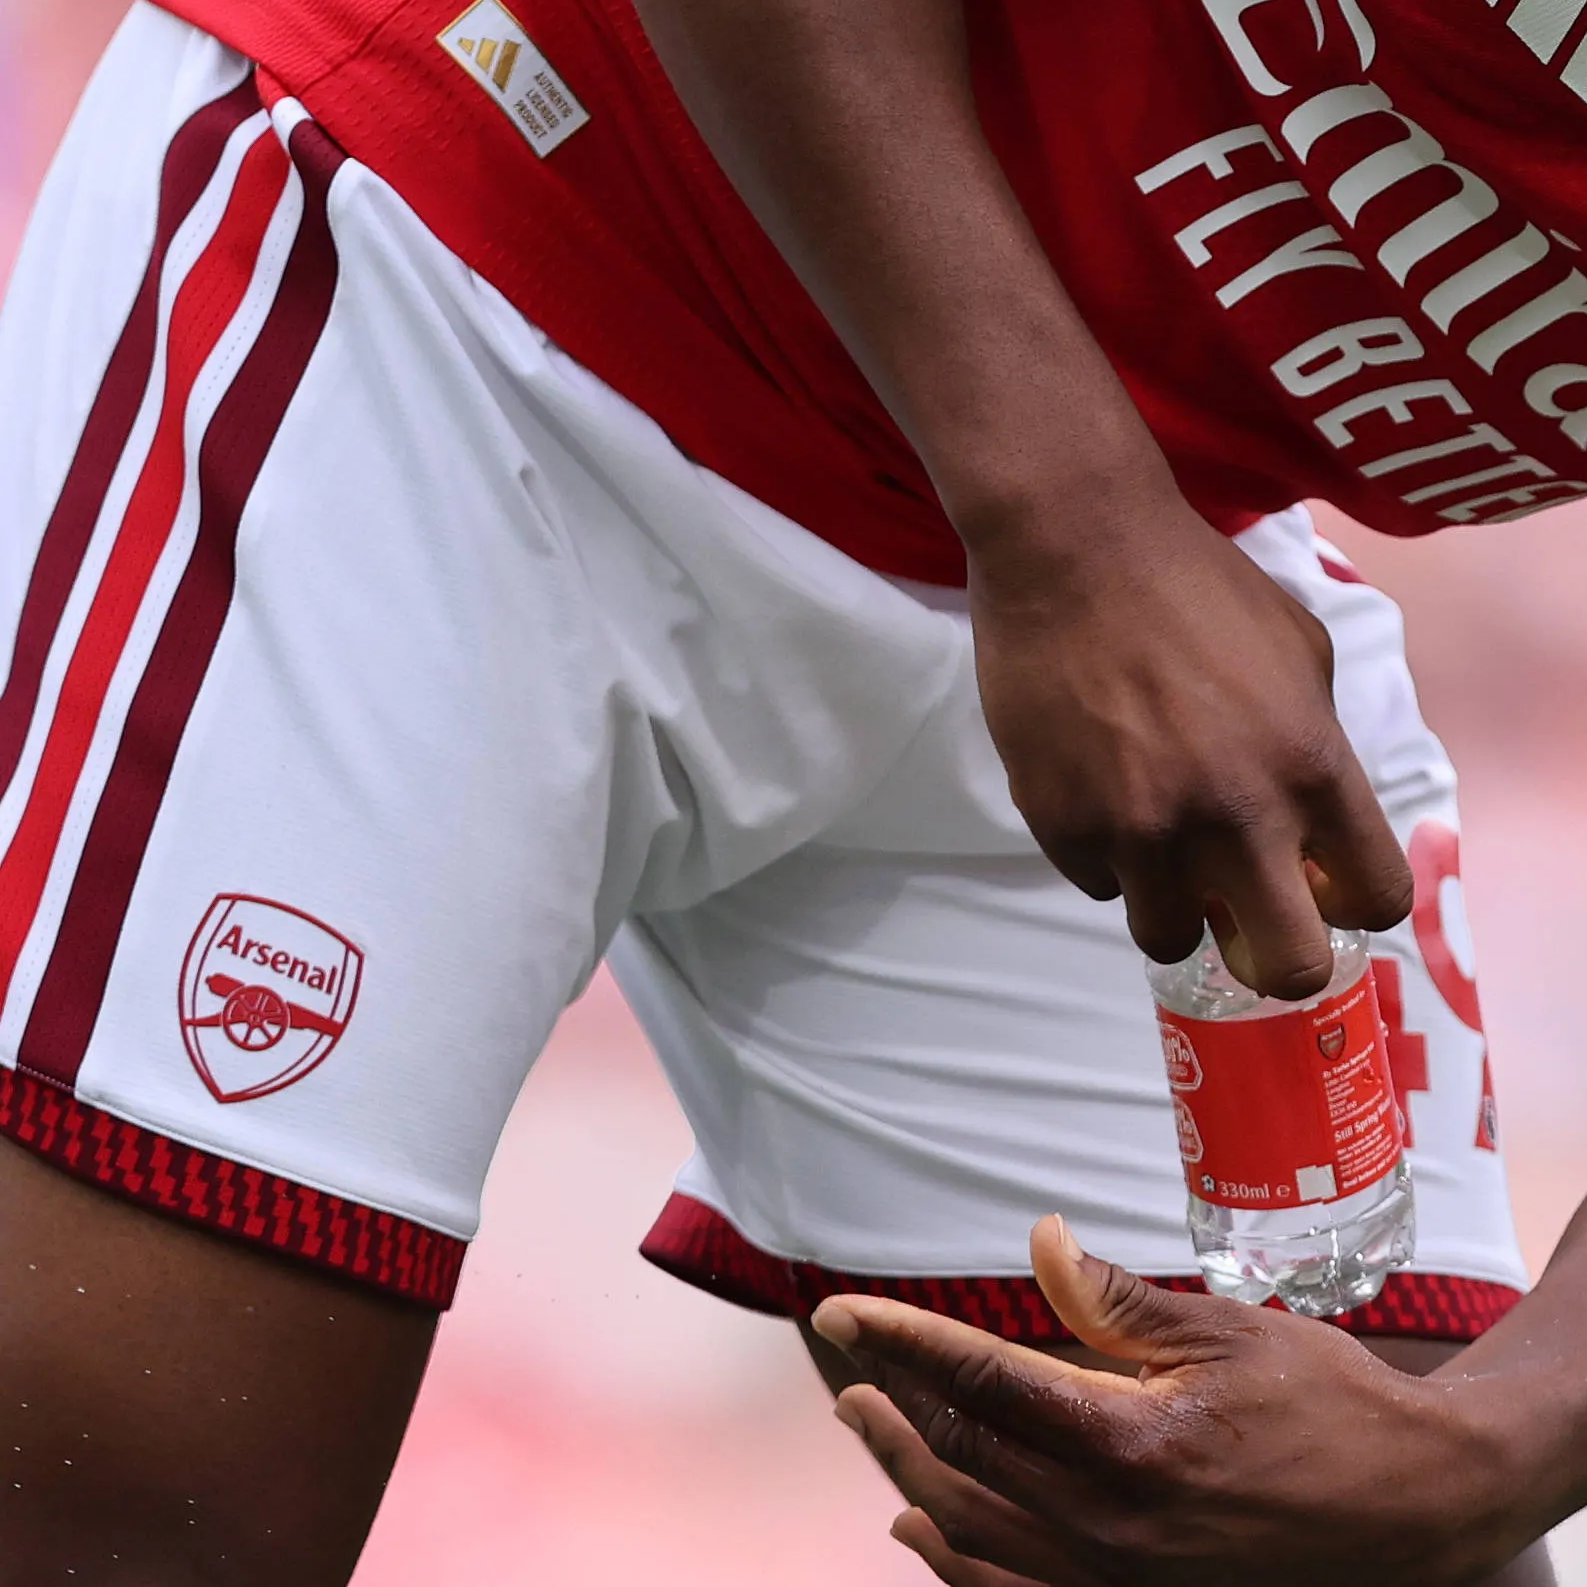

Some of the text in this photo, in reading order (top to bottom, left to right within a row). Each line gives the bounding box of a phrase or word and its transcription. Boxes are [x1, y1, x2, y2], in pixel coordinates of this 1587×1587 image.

[1133, 123, 1365, 310] FLY
[216, 924, 338, 996] Arsenal
[1219, 1181, 1271, 1200] 330ml
